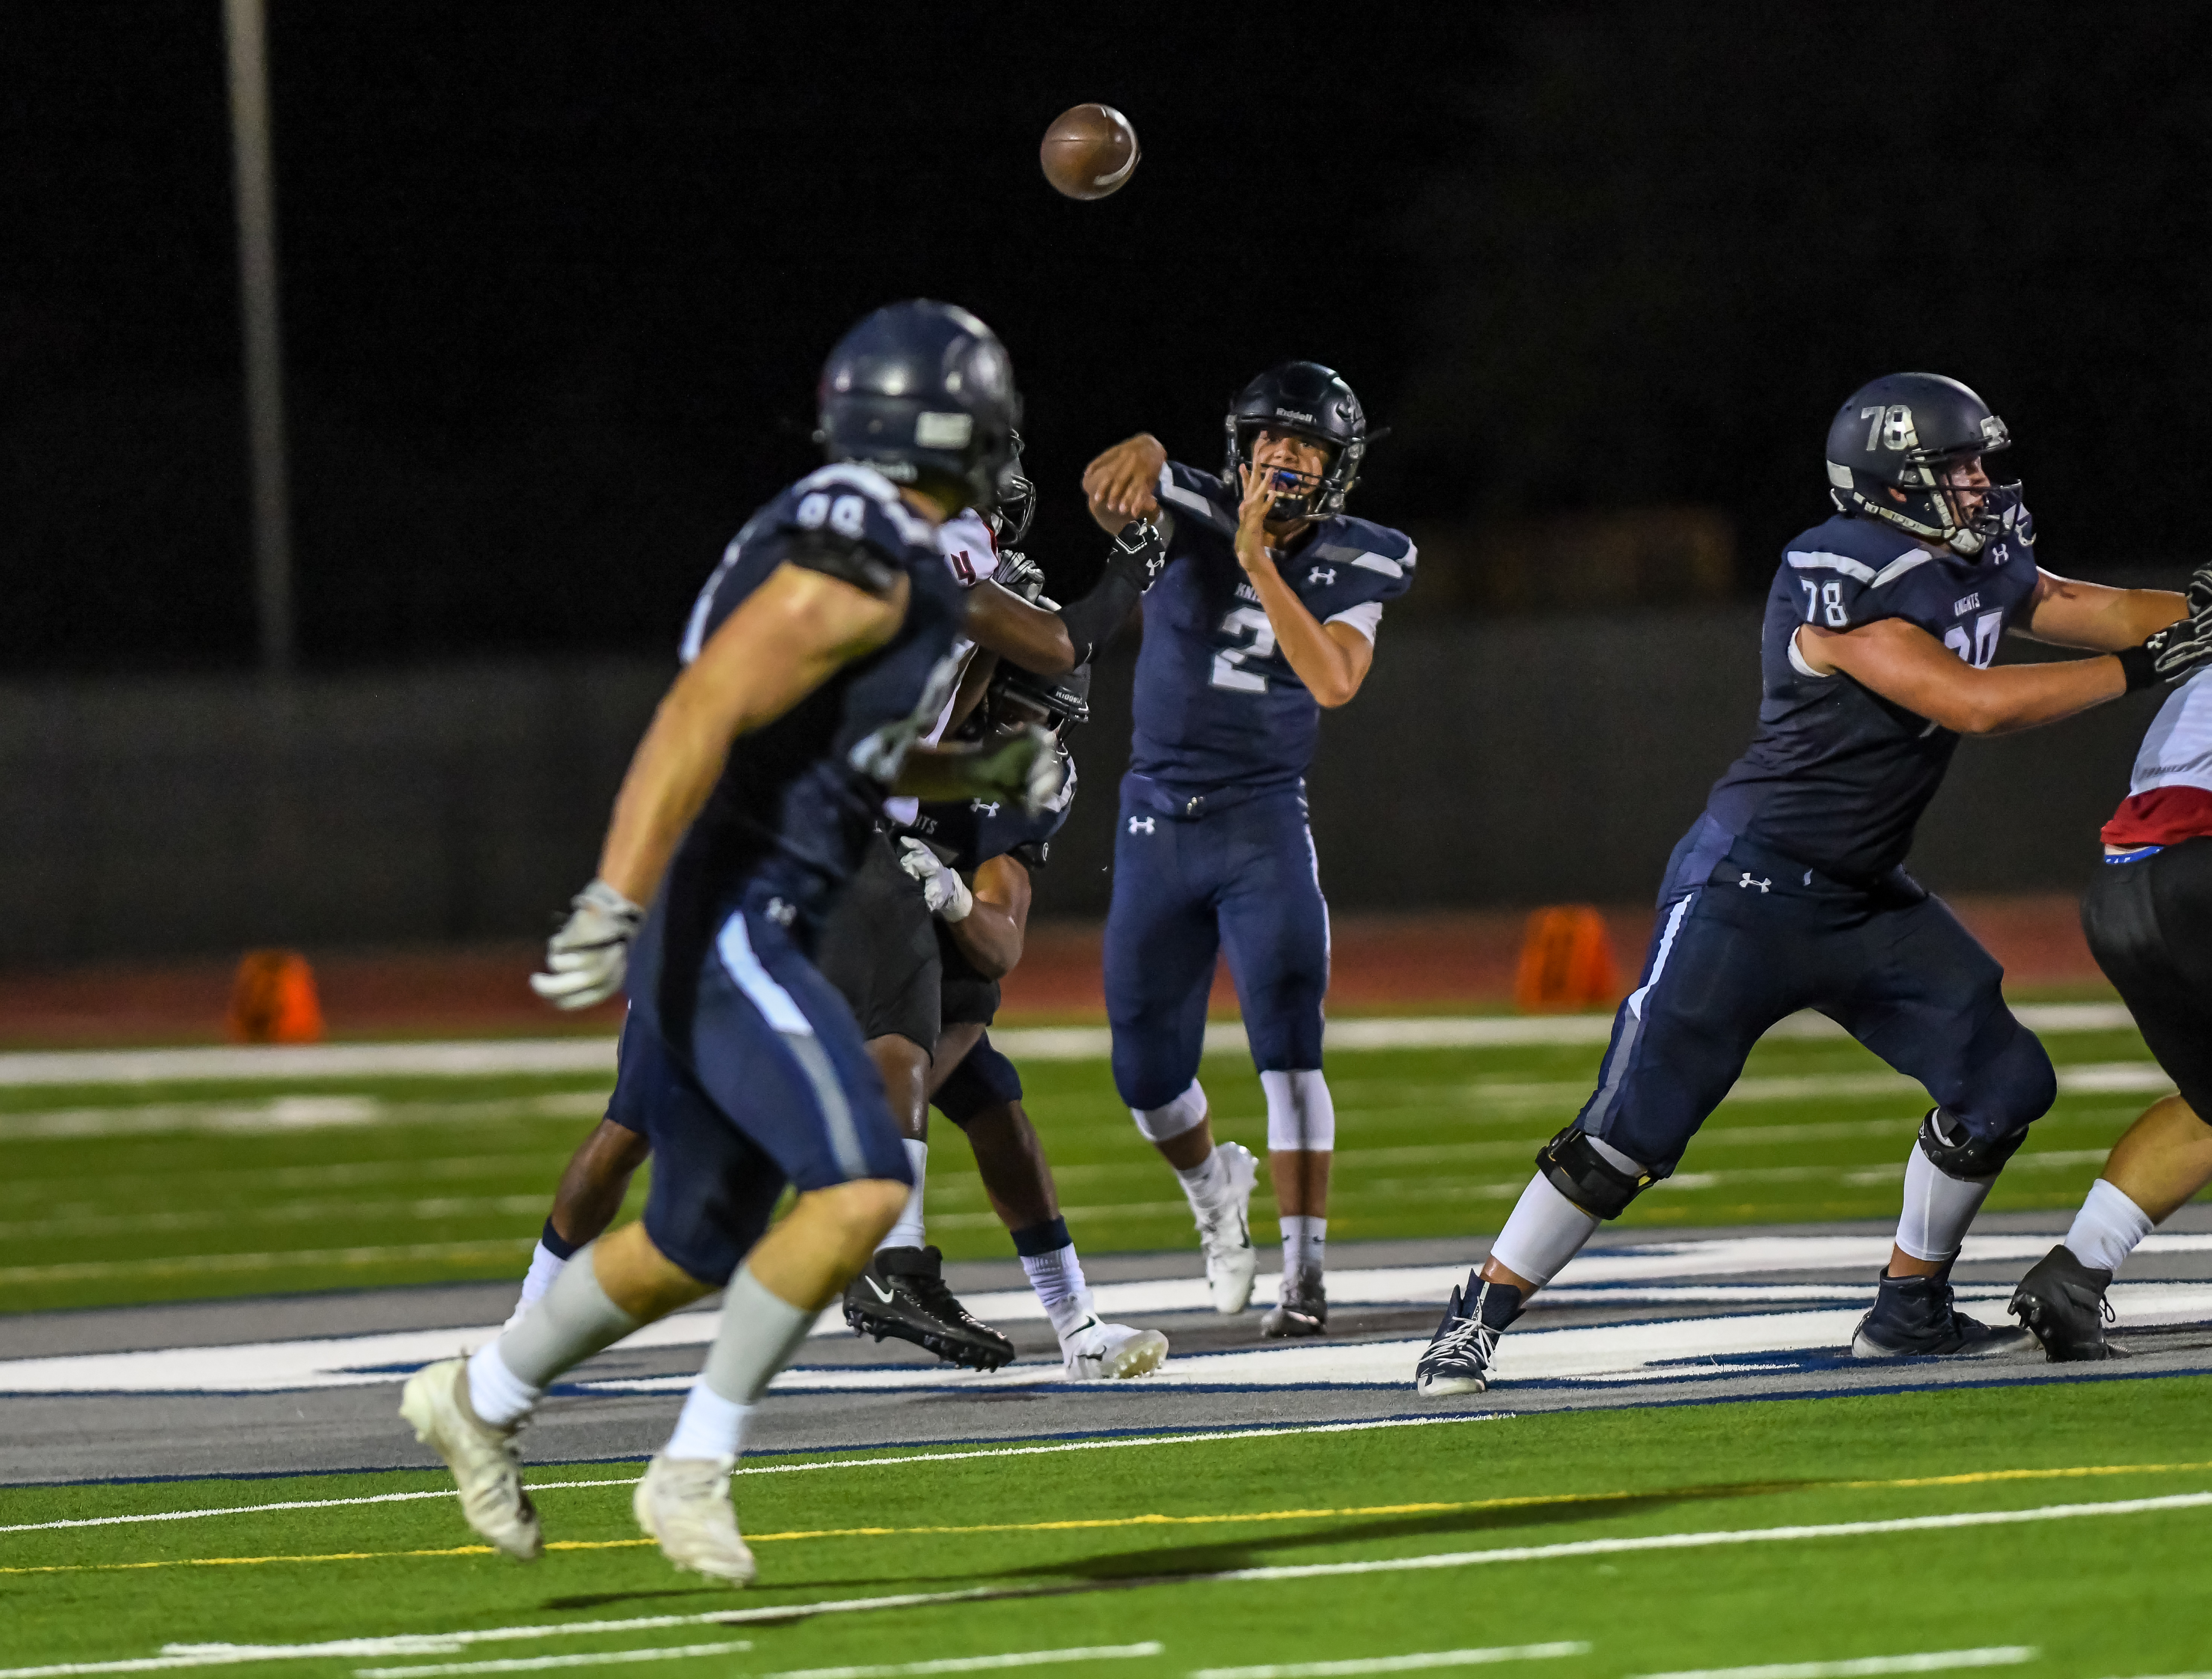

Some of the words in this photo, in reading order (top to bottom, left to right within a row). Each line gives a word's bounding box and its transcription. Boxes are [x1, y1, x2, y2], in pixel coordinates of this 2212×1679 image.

[1861, 404, 1919, 451] 78
[1801, 578, 1848, 627] 78
[1210, 606, 1277, 693] 2
